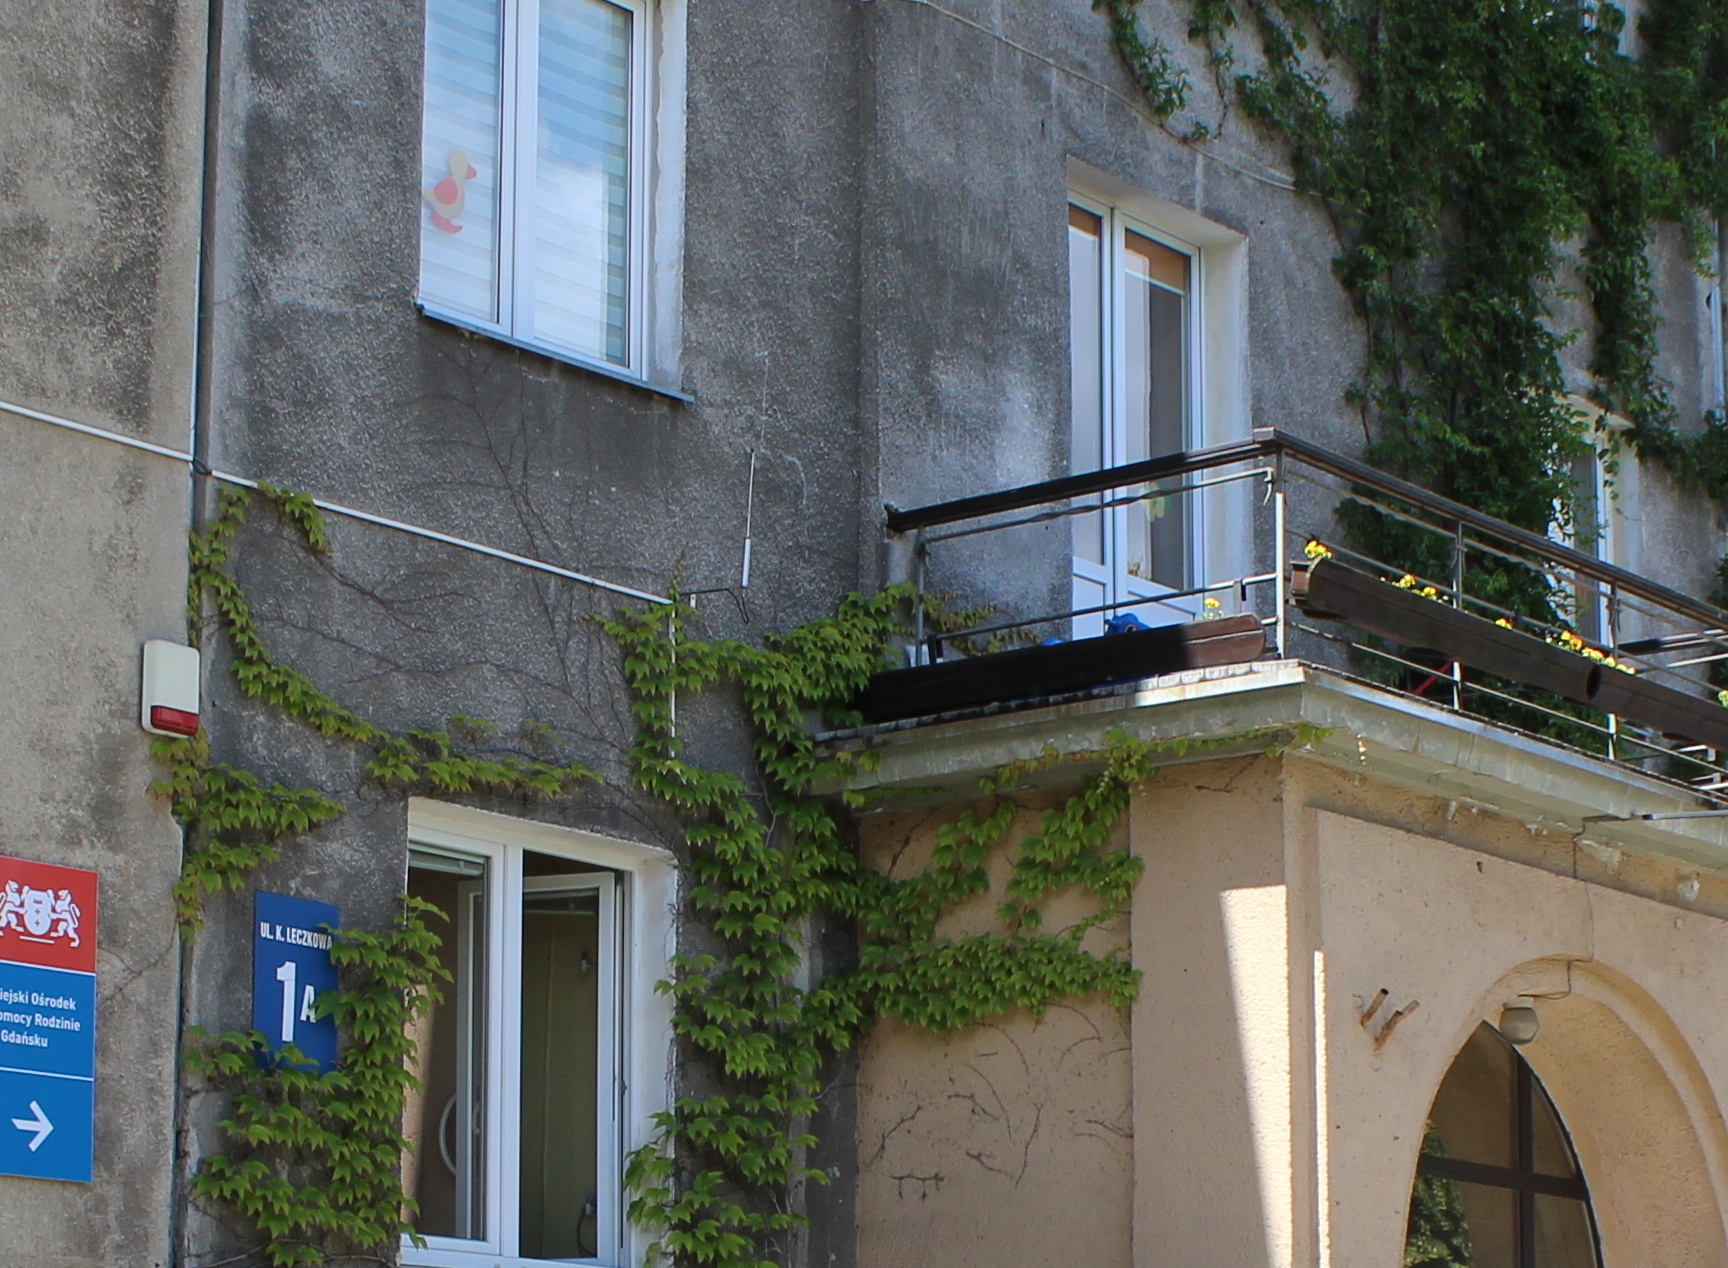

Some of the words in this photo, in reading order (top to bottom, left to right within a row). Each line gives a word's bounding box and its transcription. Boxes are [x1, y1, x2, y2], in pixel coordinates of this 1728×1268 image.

[260, 921, 274, 940] UL.
[275, 924, 285, 942] K.
[31, 992, 77, 1011] Ośrodek
[34, 1013, 81, 1032] Rodzinie
[0, 1029, 48, 1049] Gdańsku
